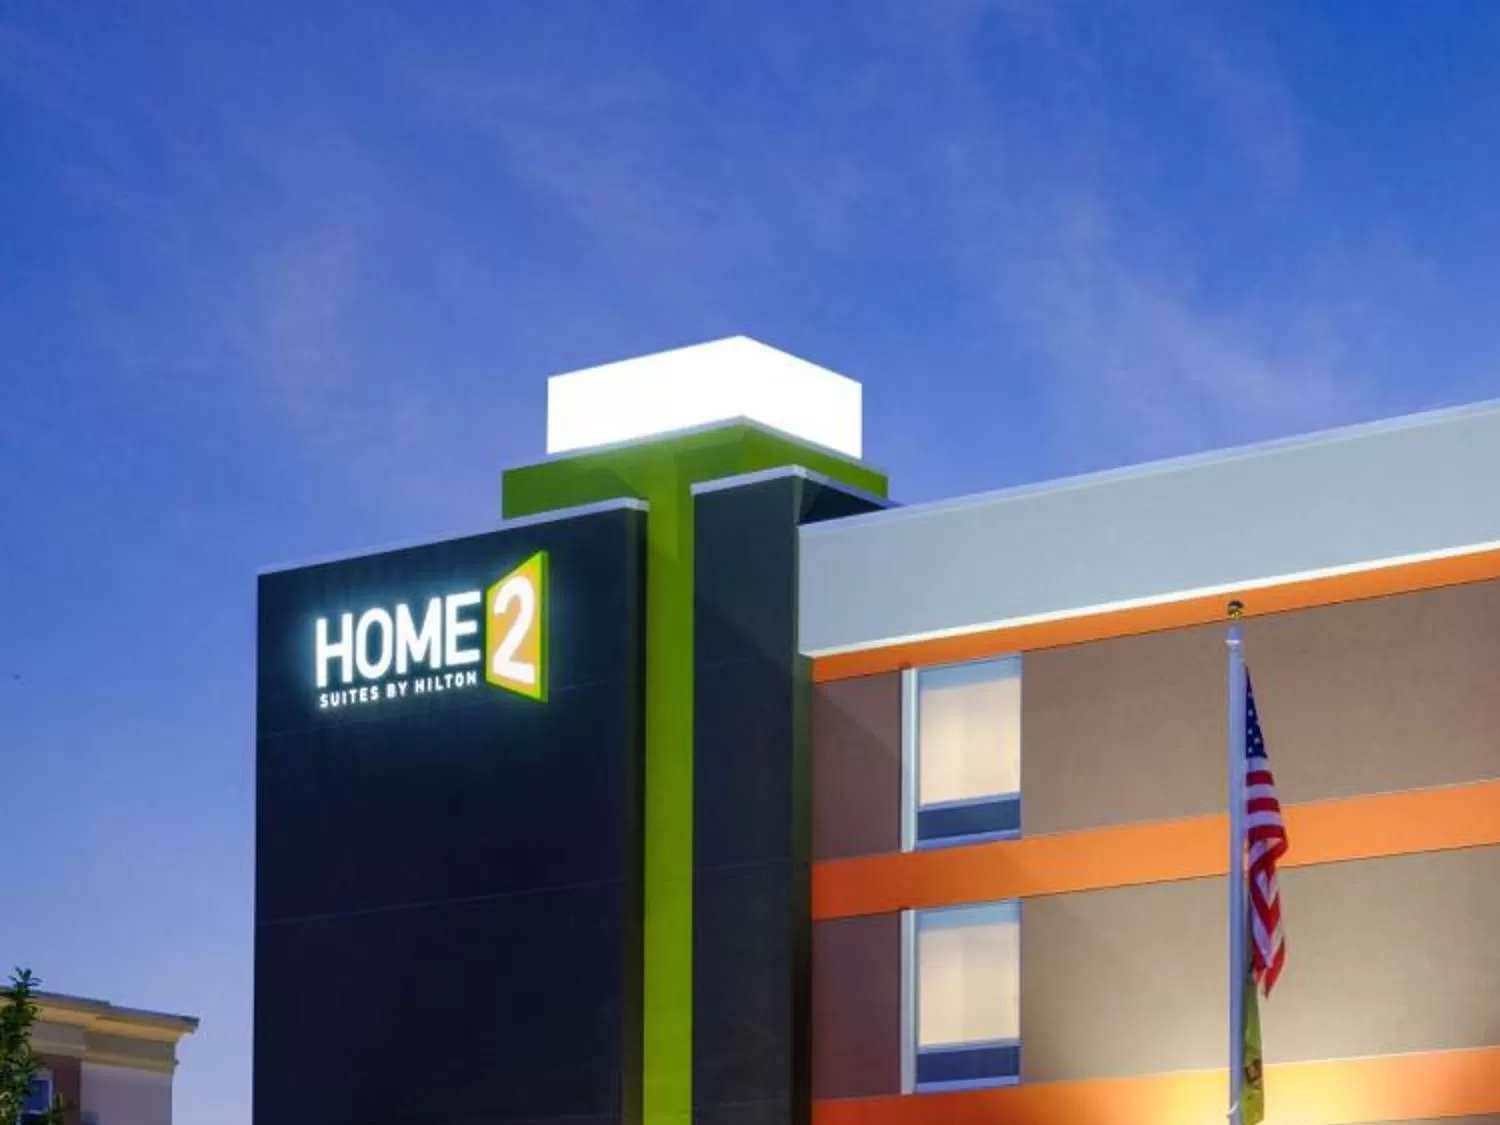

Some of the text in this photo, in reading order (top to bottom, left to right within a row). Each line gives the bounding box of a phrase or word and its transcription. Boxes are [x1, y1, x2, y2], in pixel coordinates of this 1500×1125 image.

[316, 575, 536, 688] HOME 2
[319, 670, 477, 708] SUITES BY HILTON
